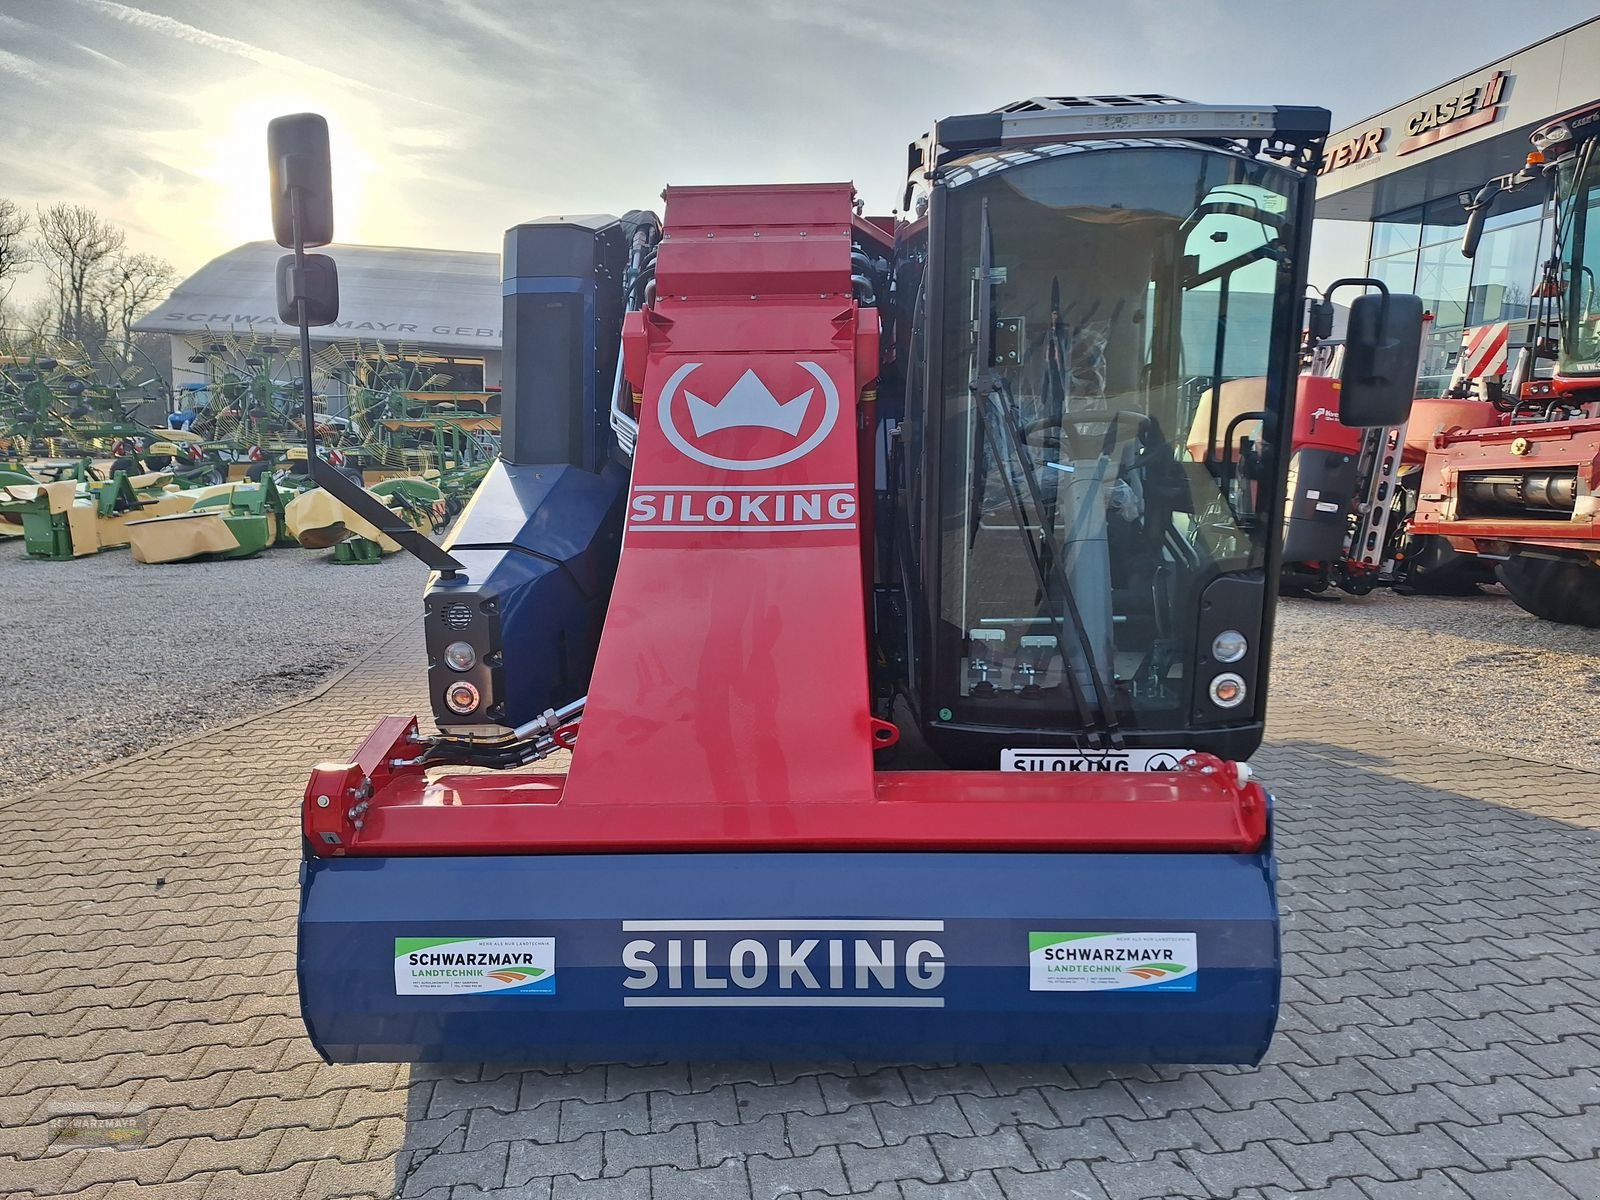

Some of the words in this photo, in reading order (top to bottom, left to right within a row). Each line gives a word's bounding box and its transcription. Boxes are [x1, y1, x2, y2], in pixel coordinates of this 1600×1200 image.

[1404, 88, 1480, 136] CASE
[1317, 127, 1385, 176] TEYR
[164, 312, 418, 334] SCHWAMAYR
[432, 325, 503, 339] GEB
[630, 493, 856, 522] SILOKING
[409, 953, 533, 966] SCHWARZMAYR
[622, 939, 945, 989] SILOKING
[1044, 948, 1173, 961] SCHWARZMAYR
[411, 969, 484, 977] LANDTECHNIK
[1047, 965, 1122, 973] LANDTECHNIK
